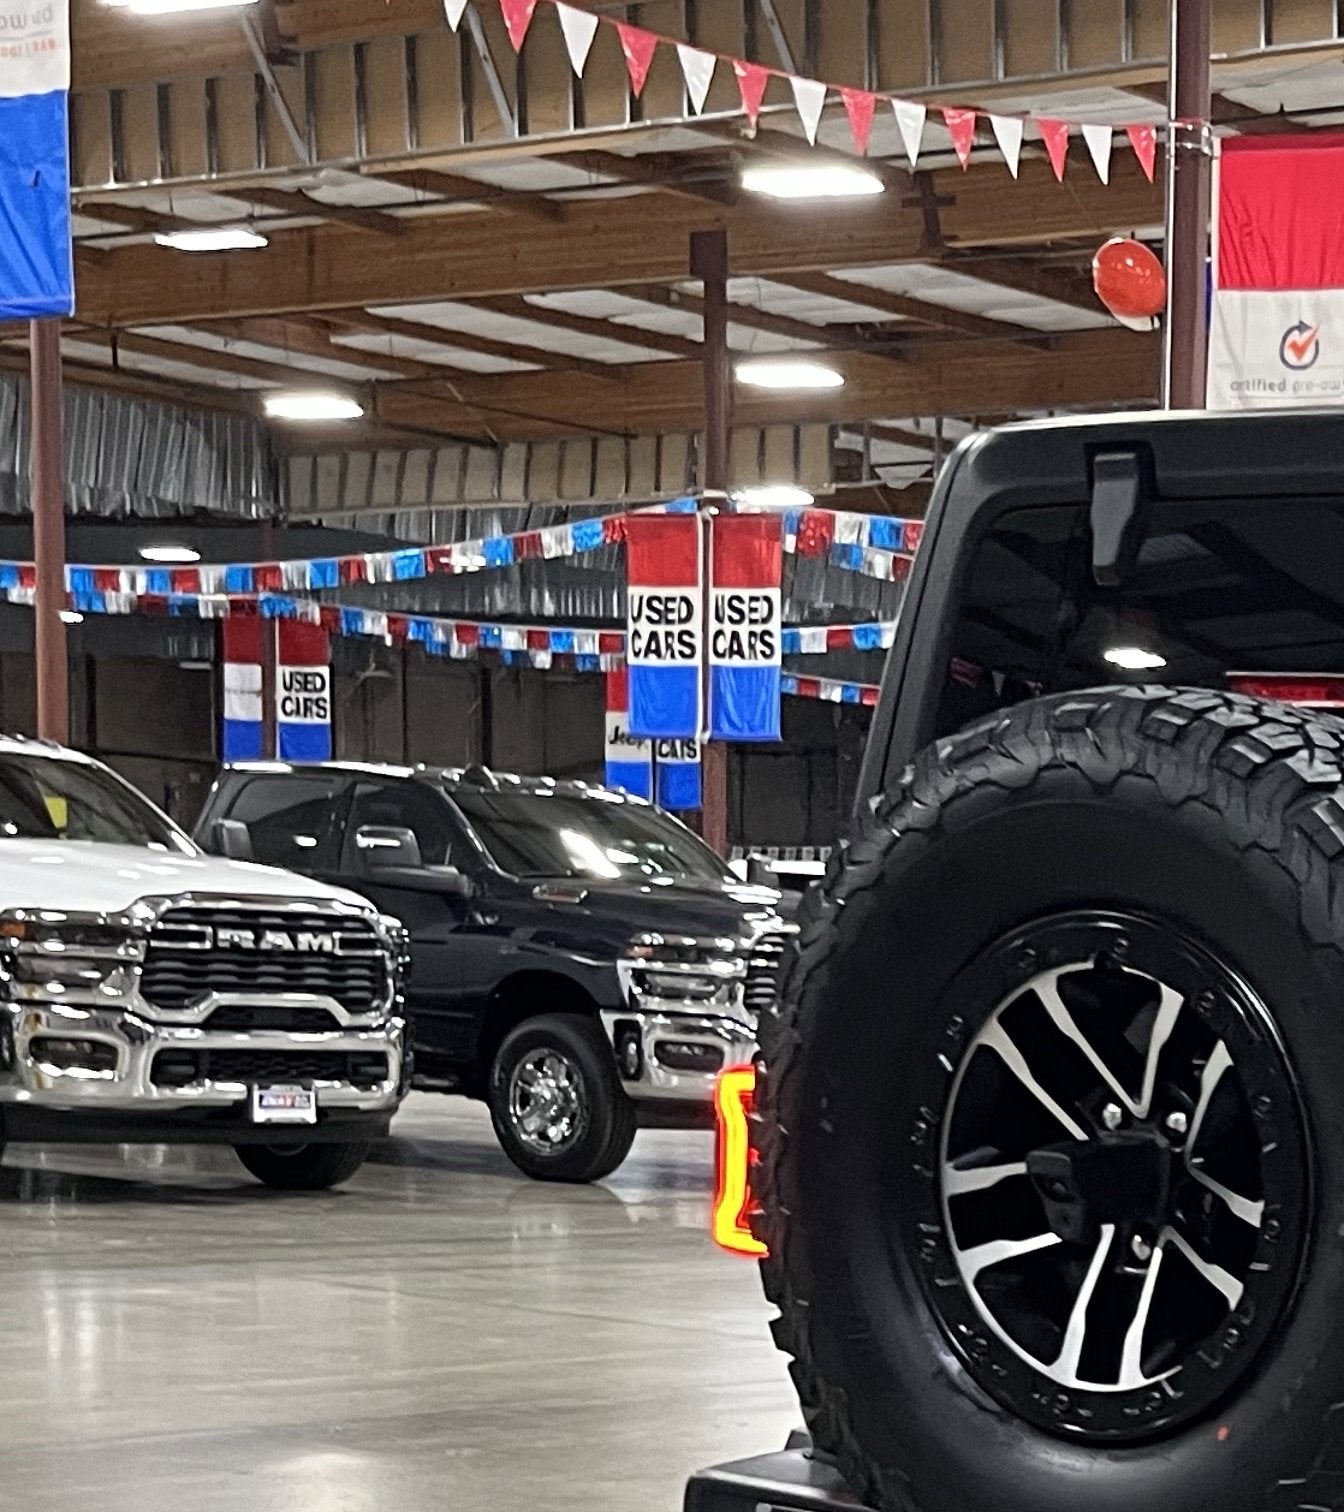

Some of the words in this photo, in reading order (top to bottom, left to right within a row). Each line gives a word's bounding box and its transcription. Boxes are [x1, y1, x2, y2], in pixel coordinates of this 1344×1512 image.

[630, 594, 695, 625] USED
[714, 594, 774, 625] USED
[630, 628, 697, 660] CARS
[712, 628, 776, 660] CARS
[282, 669, 327, 693] USED
[216, 927, 333, 952] RAM
